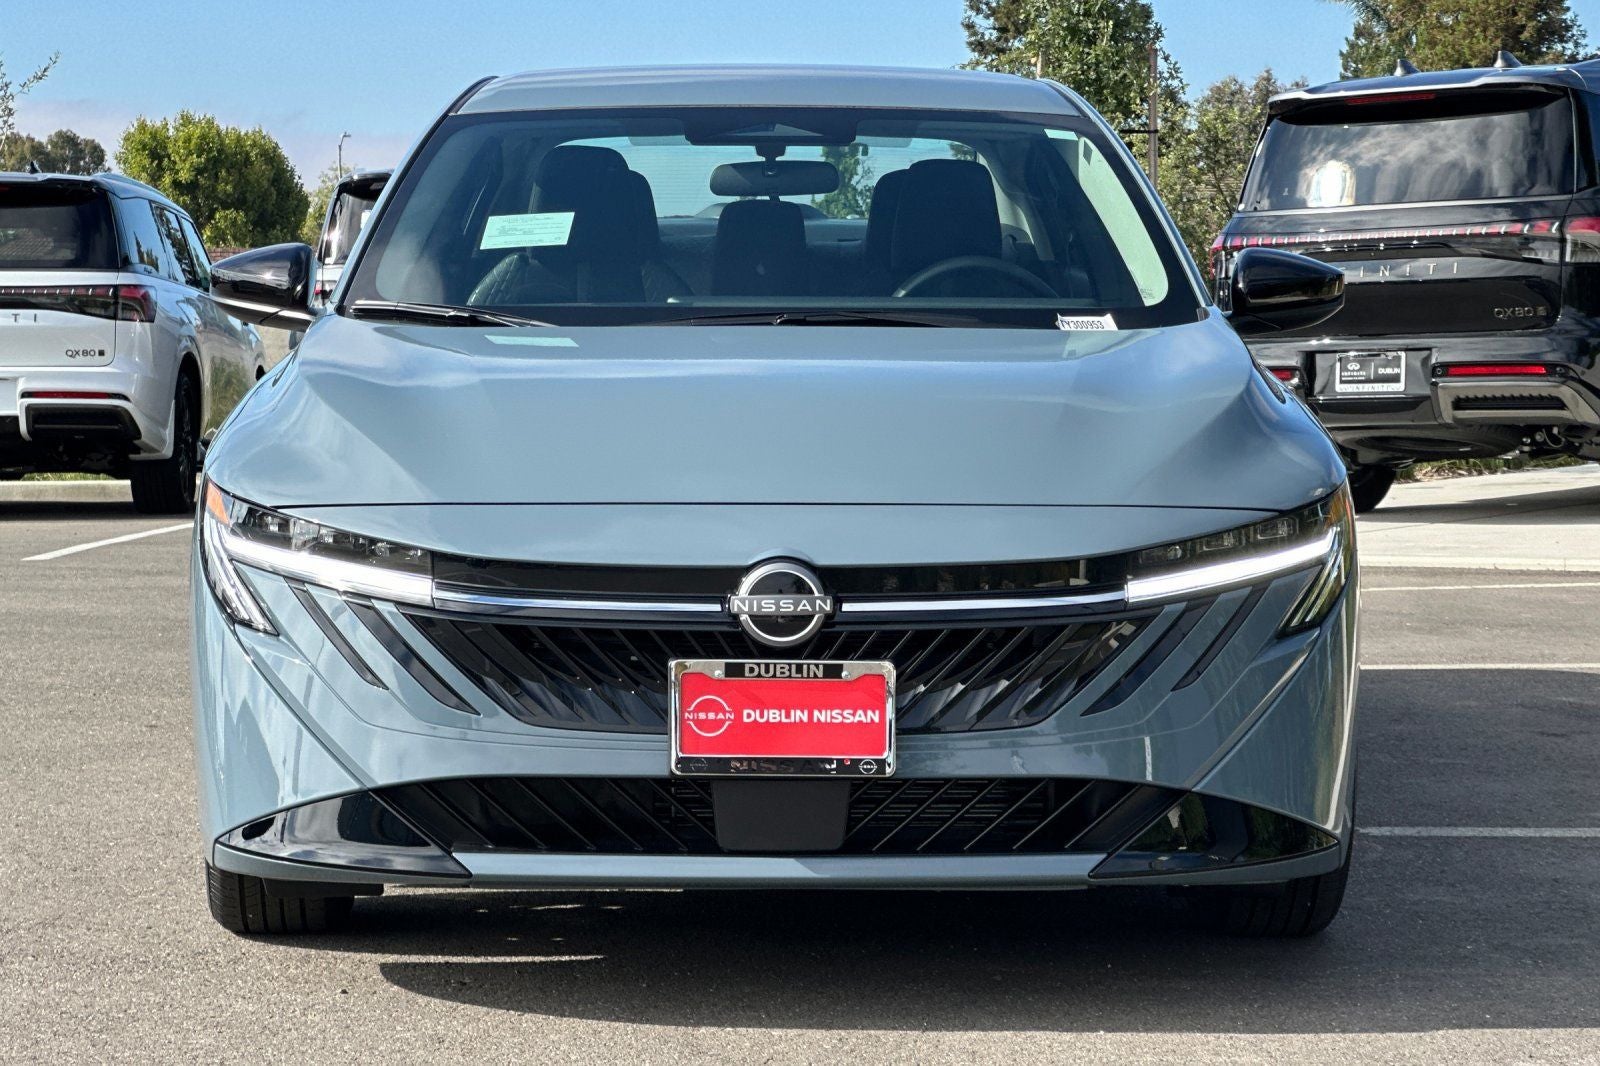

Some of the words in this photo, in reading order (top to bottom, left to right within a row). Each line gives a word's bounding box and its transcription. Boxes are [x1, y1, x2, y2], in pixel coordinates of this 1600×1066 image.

[1340, 262, 1458, 278] INITI
[65, 349, 96, 358] QX80
[734, 599, 831, 612] NISSAN
[744, 663, 824, 678] DUBLIN
[684, 711, 735, 720] NISSAN
[742, 709, 808, 723] DUBLIN
[813, 709, 880, 723] NISSAN
